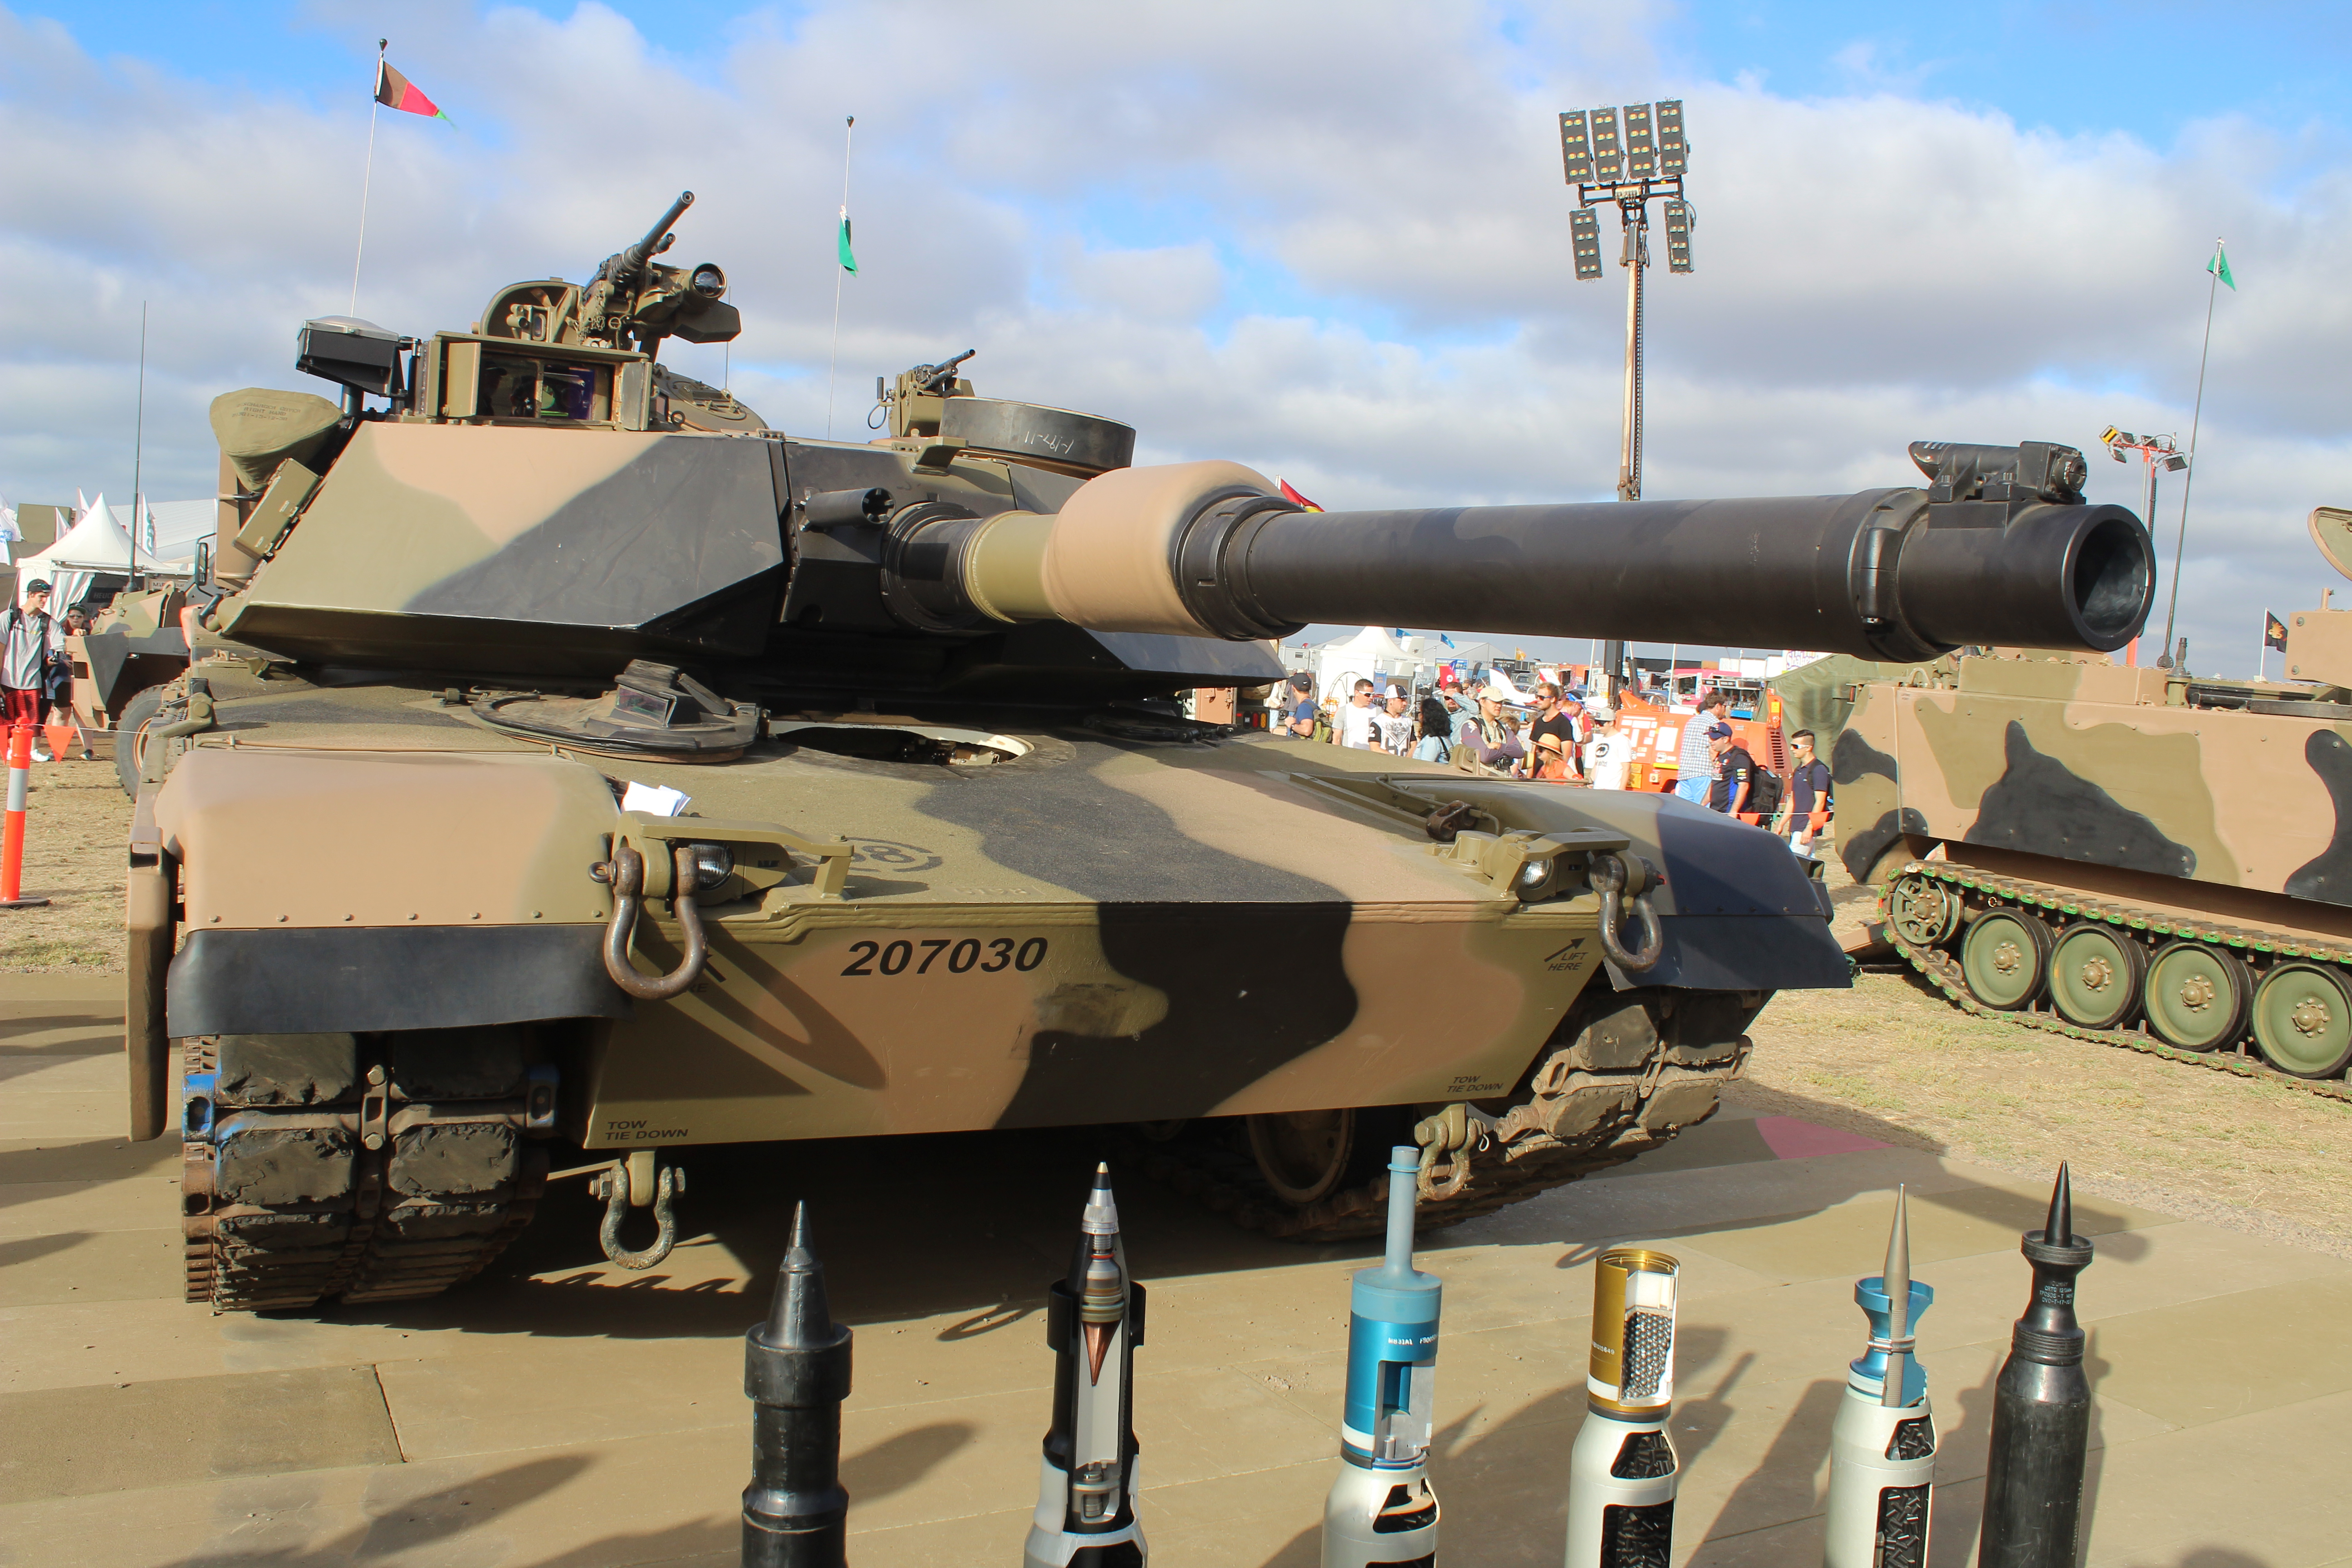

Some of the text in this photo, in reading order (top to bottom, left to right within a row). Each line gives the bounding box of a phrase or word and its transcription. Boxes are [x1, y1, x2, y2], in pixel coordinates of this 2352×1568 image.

[840, 937, 1048, 976] 207030
[1561, 952, 1589, 961] LIFT
[1548, 962, 1583, 971] HERE
[1453, 1075, 1481, 1084] TOW
[1446, 1083, 1504, 1093] TIE DOWN
[607, 1120, 647, 1130] TOW
[605, 1128, 689, 1141] TIE DOWN
[1388, 1337, 1413, 1346] M831A1
